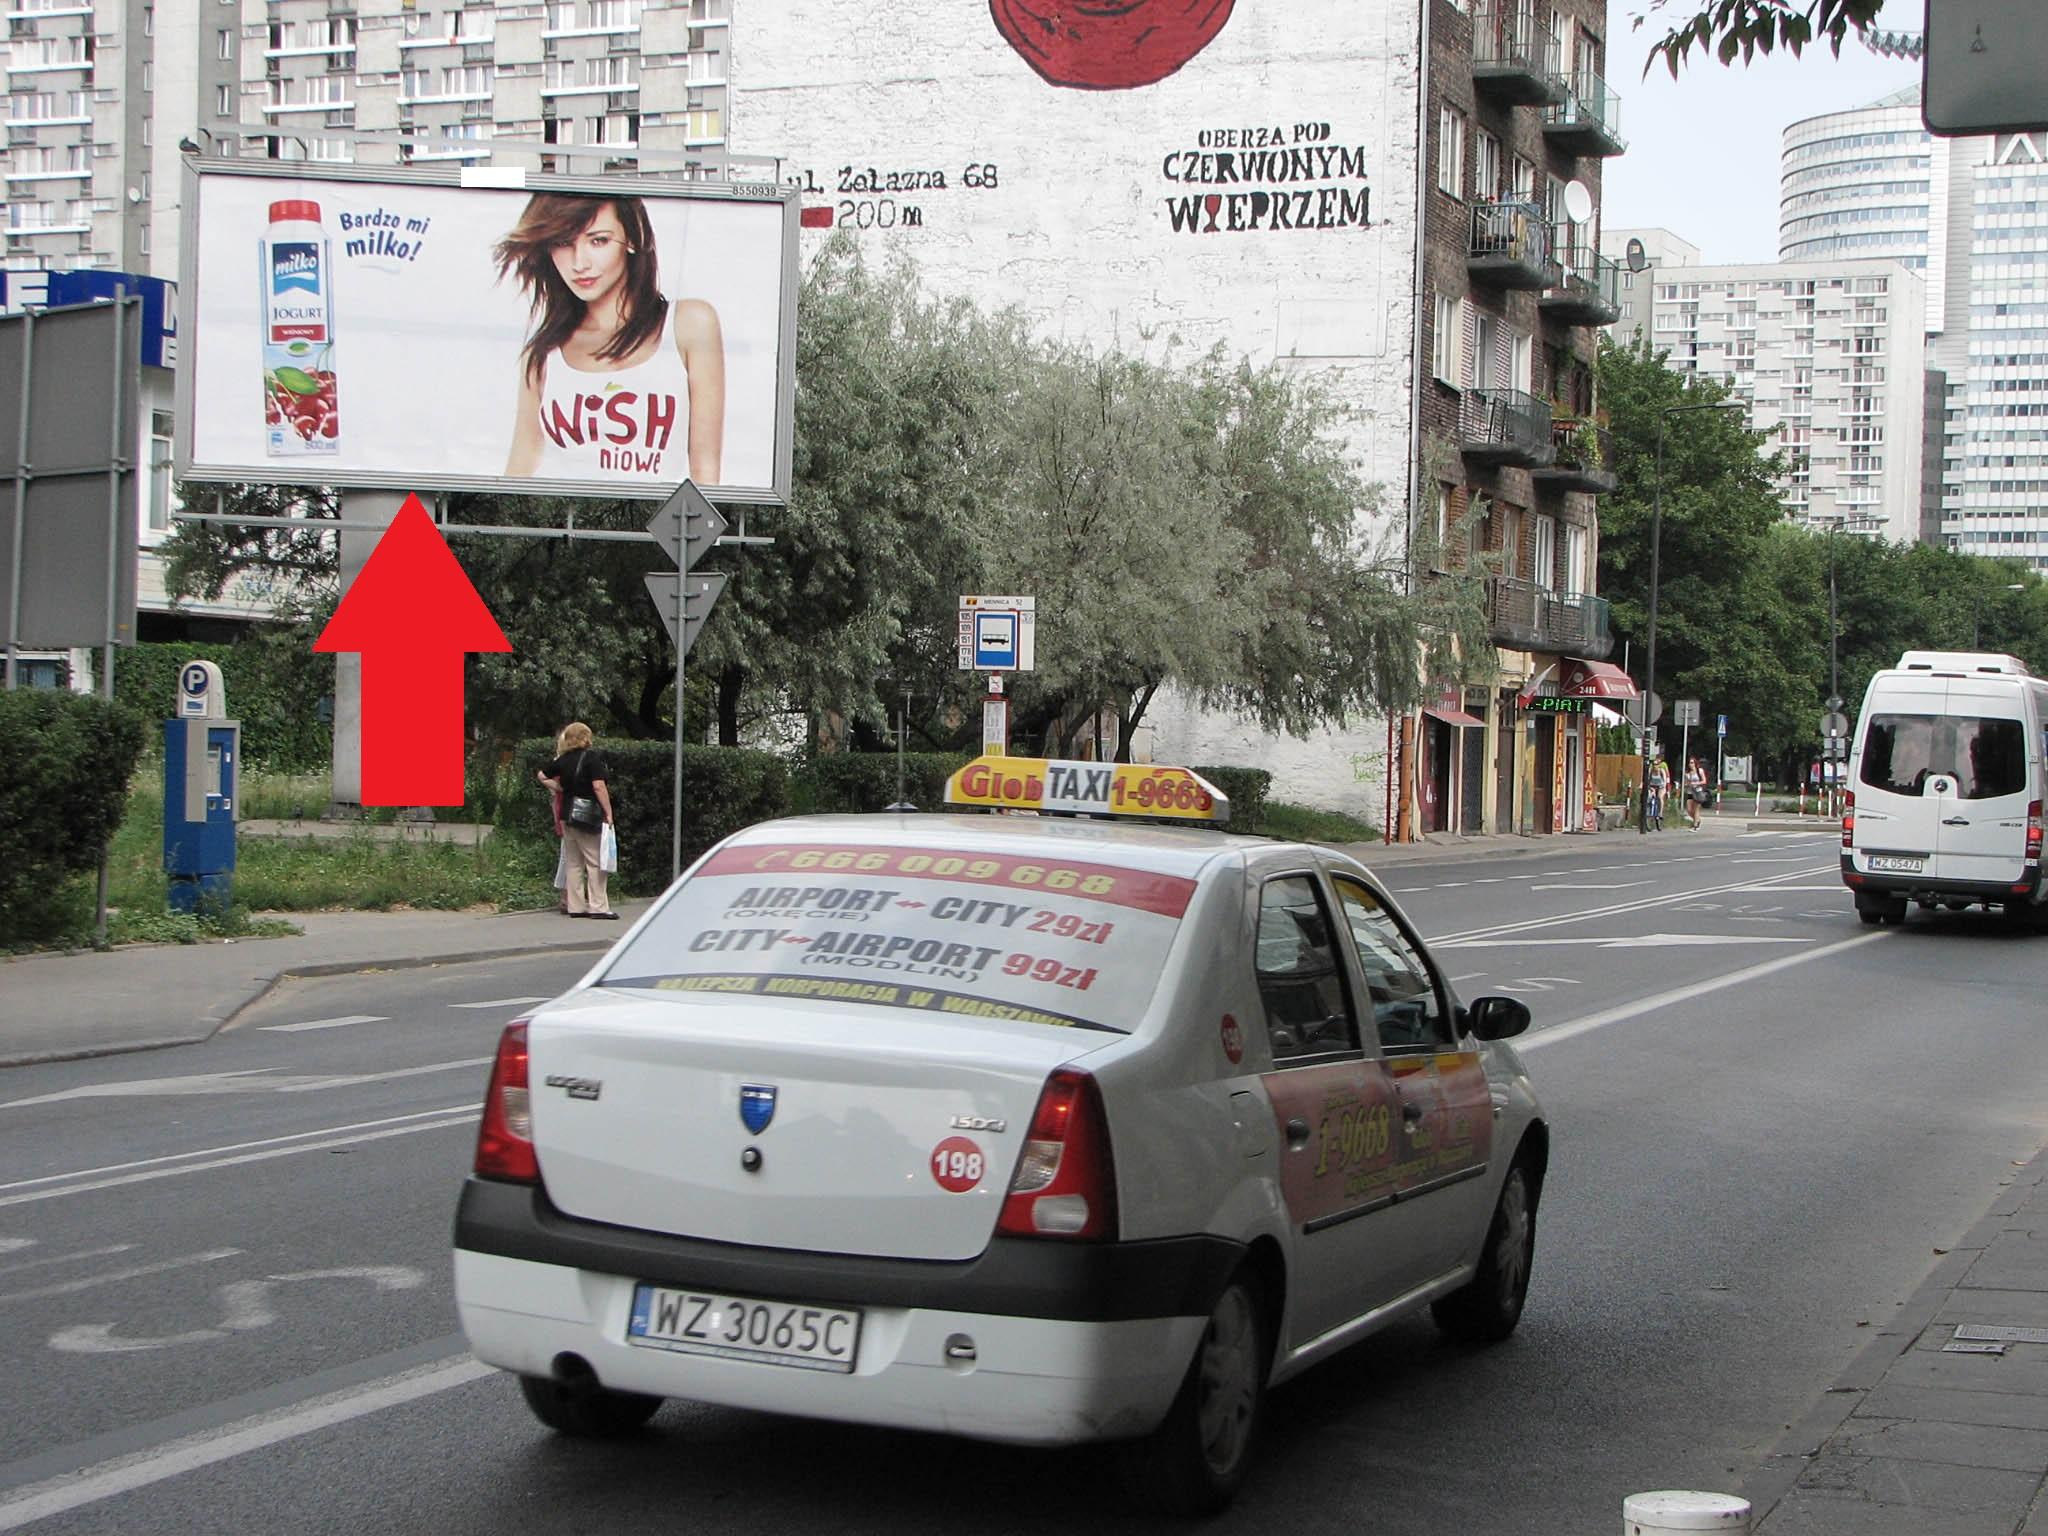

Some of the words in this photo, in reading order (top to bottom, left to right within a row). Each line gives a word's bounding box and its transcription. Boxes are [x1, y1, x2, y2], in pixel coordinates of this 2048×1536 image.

[1293, 122, 1331, 143] POD
[963, 164, 998, 188] 68
[1163, 145, 1368, 183] CZERWONYM
[732, 186, 777, 196] 8550939
[339, 208, 400, 231] Bardzo
[406, 217, 431, 234] mi
[838, 200, 897, 229] 200
[1165, 186, 1371, 233] WIEPRZEM
[346, 230, 423, 262] milko!
[275, 252, 317, 275] milko
[273, 307, 323, 320] JOGURT
[961, 764, 1044, 801] Glob
[1049, 767, 1111, 802] TAXI
[790, 850, 892, 870] 666
[897, 855, 1001, 878] 009
[1008, 866, 1117, 895] 668
[1874, 858, 1888, 868] WZ
[727, 887, 899, 912] AIRPORT
[930, 897, 1031, 928] CITY
[688, 929, 793, 952] CITY
[805, 931, 1003, 971] AIRPORT
[801, 954, 979, 983] (MODLIN)
[907, 991, 935, 1007] W
[935, 1150, 981, 1180] 198
[655, 1292, 713, 1338] WZ
[723, 1301, 850, 1355] 3065C
